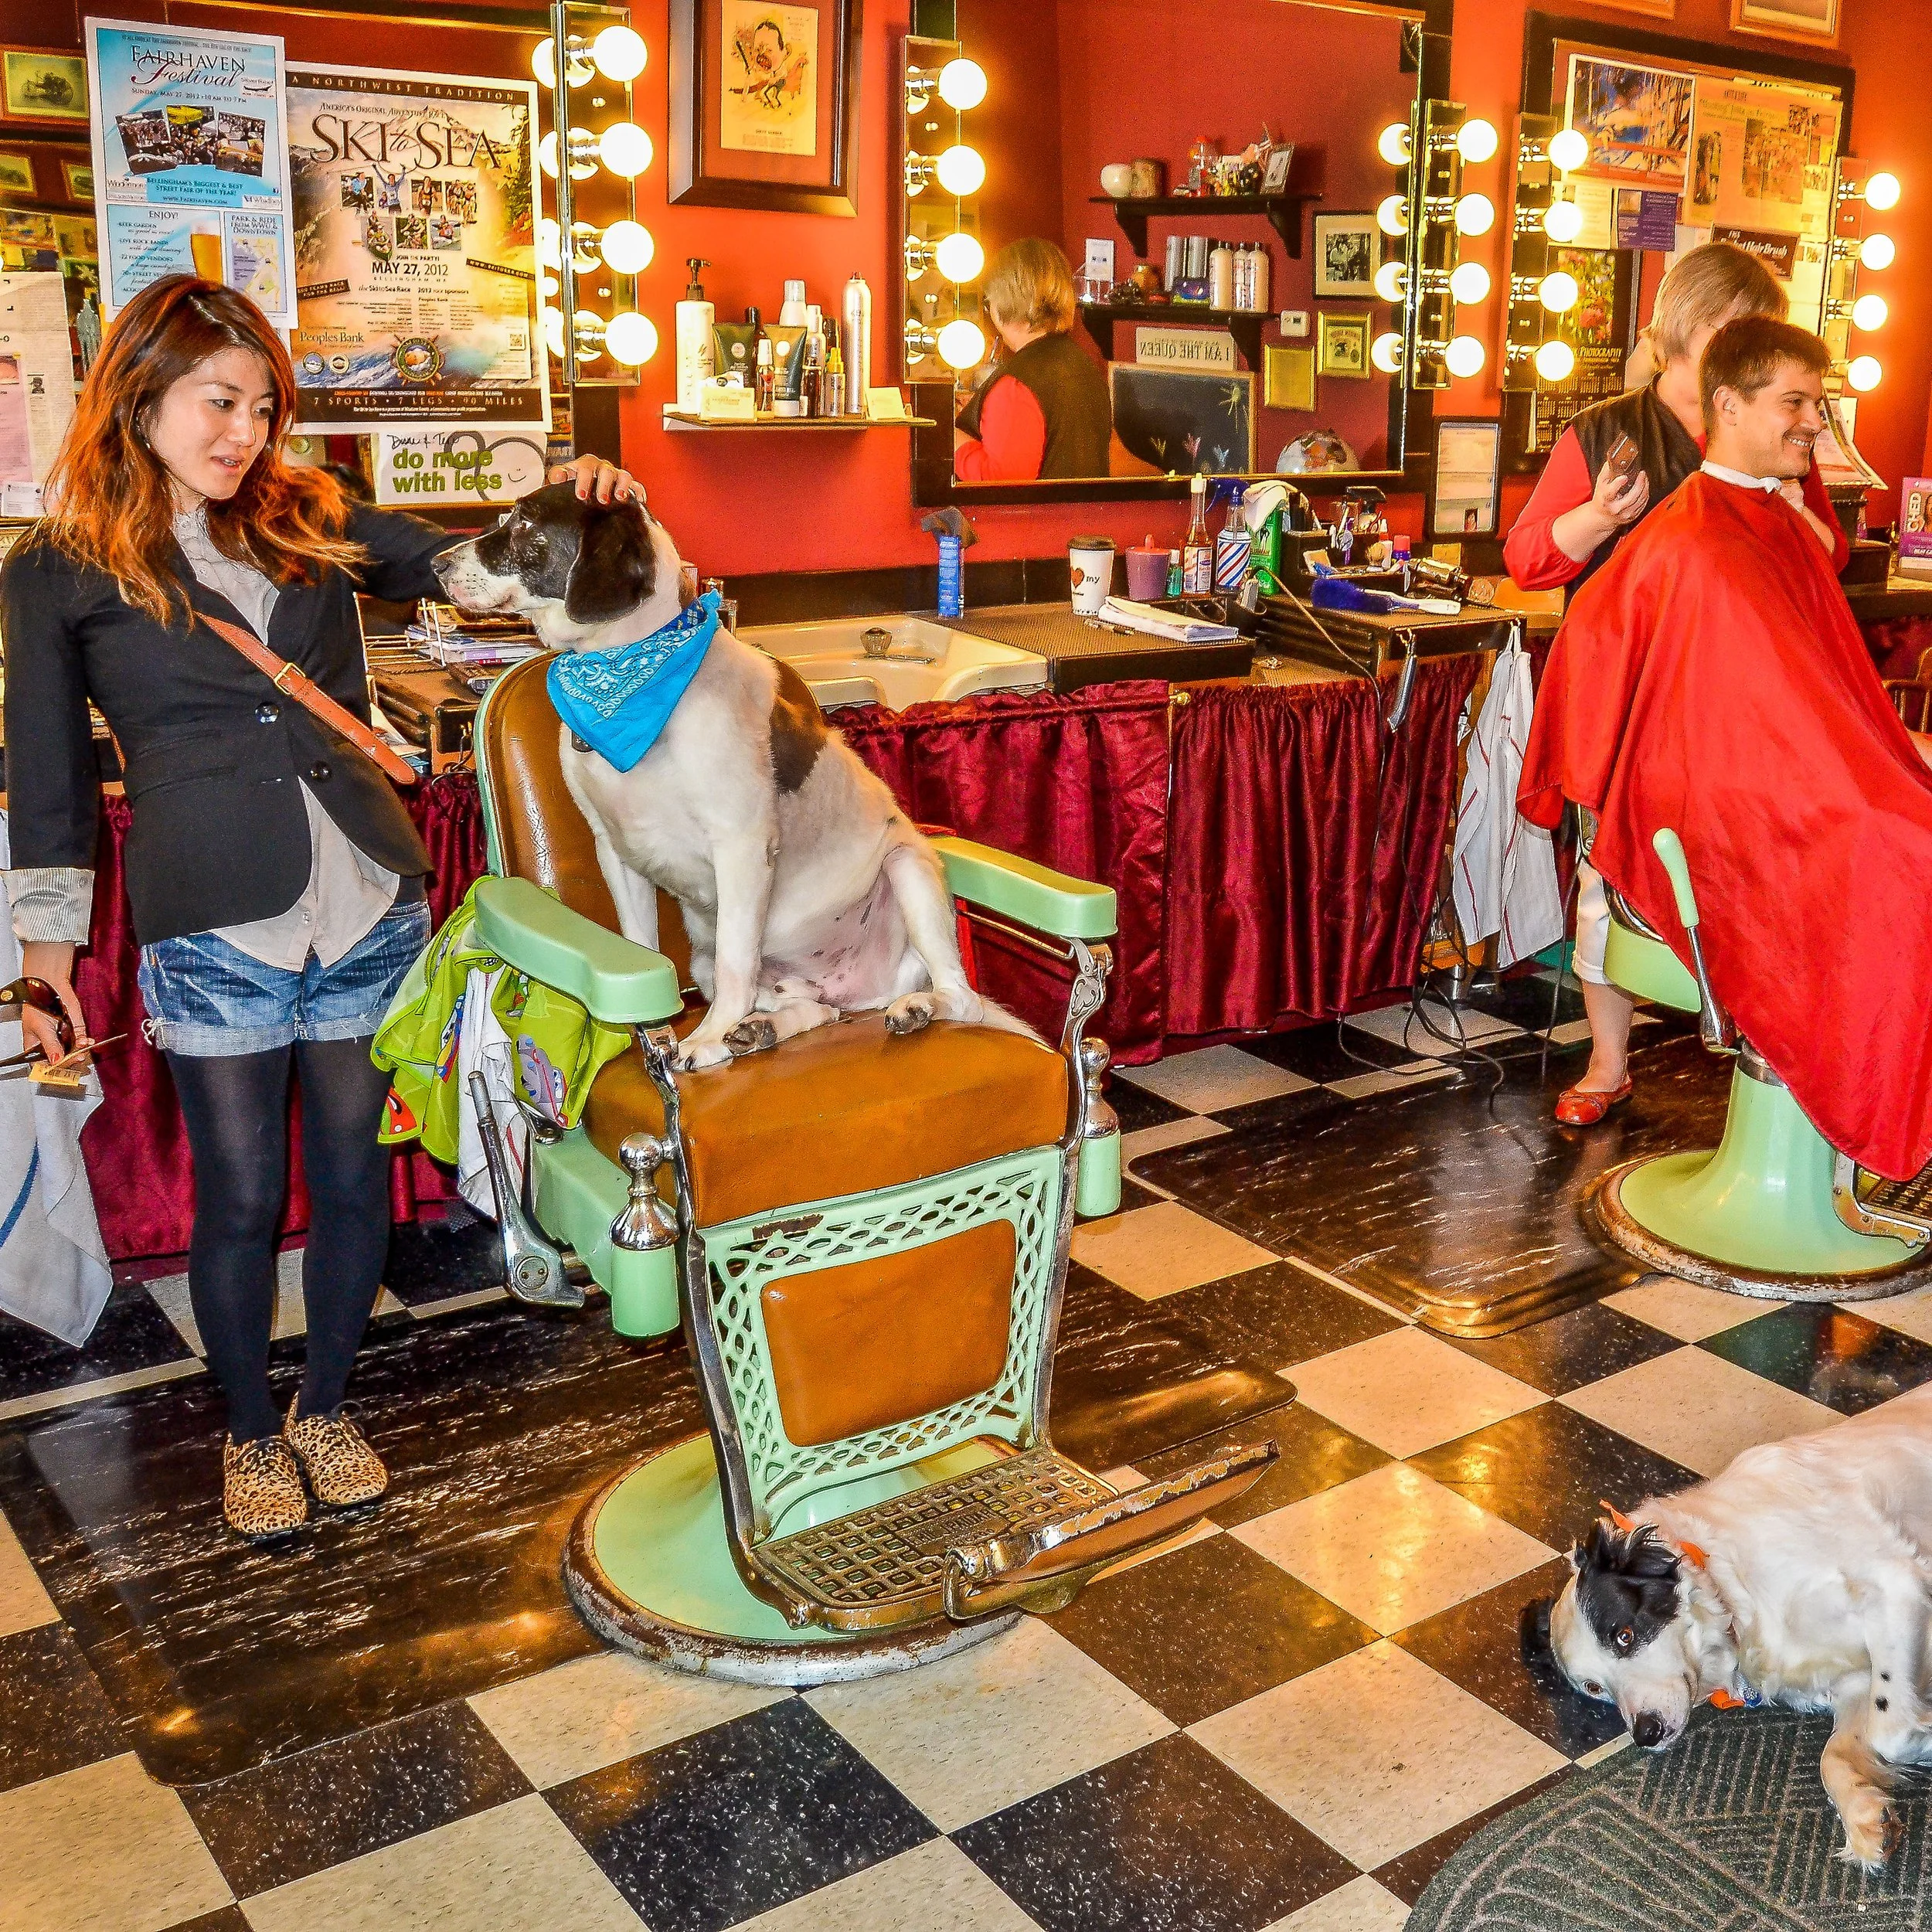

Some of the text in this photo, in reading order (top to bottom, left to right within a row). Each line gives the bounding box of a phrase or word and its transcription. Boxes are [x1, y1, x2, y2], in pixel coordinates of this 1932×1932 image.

[131, 45, 246, 72] FAIRHAVEN
[131, 56, 245, 87] Festival
[311, 77, 412, 93] NORTHWEST
[424, 85, 514, 101] TRADITION
[310, 114, 502, 169] SKI to SEA
[149, 210, 179, 219] ENJOY!
[233, 226, 277, 235] DOWNTOWN
[1763, 243, 1788, 259] Brush
[372, 261, 448, 276] MAY 27, 2012
[300, 331, 365, 345] Peoples Bank
[1580, 346, 1622, 358] PHOTOGRAPHY
[314, 396, 320, 406] 7
[328, 396, 377, 406] SPORTS
[398, 396, 403, 405] 7
[413, 396, 442, 405] LEGS
[485, 396, 523, 406] MILES
[393, 448, 493, 469] do more
[393, 469, 502, 493] with less
[1086, 576, 1100, 584] my
